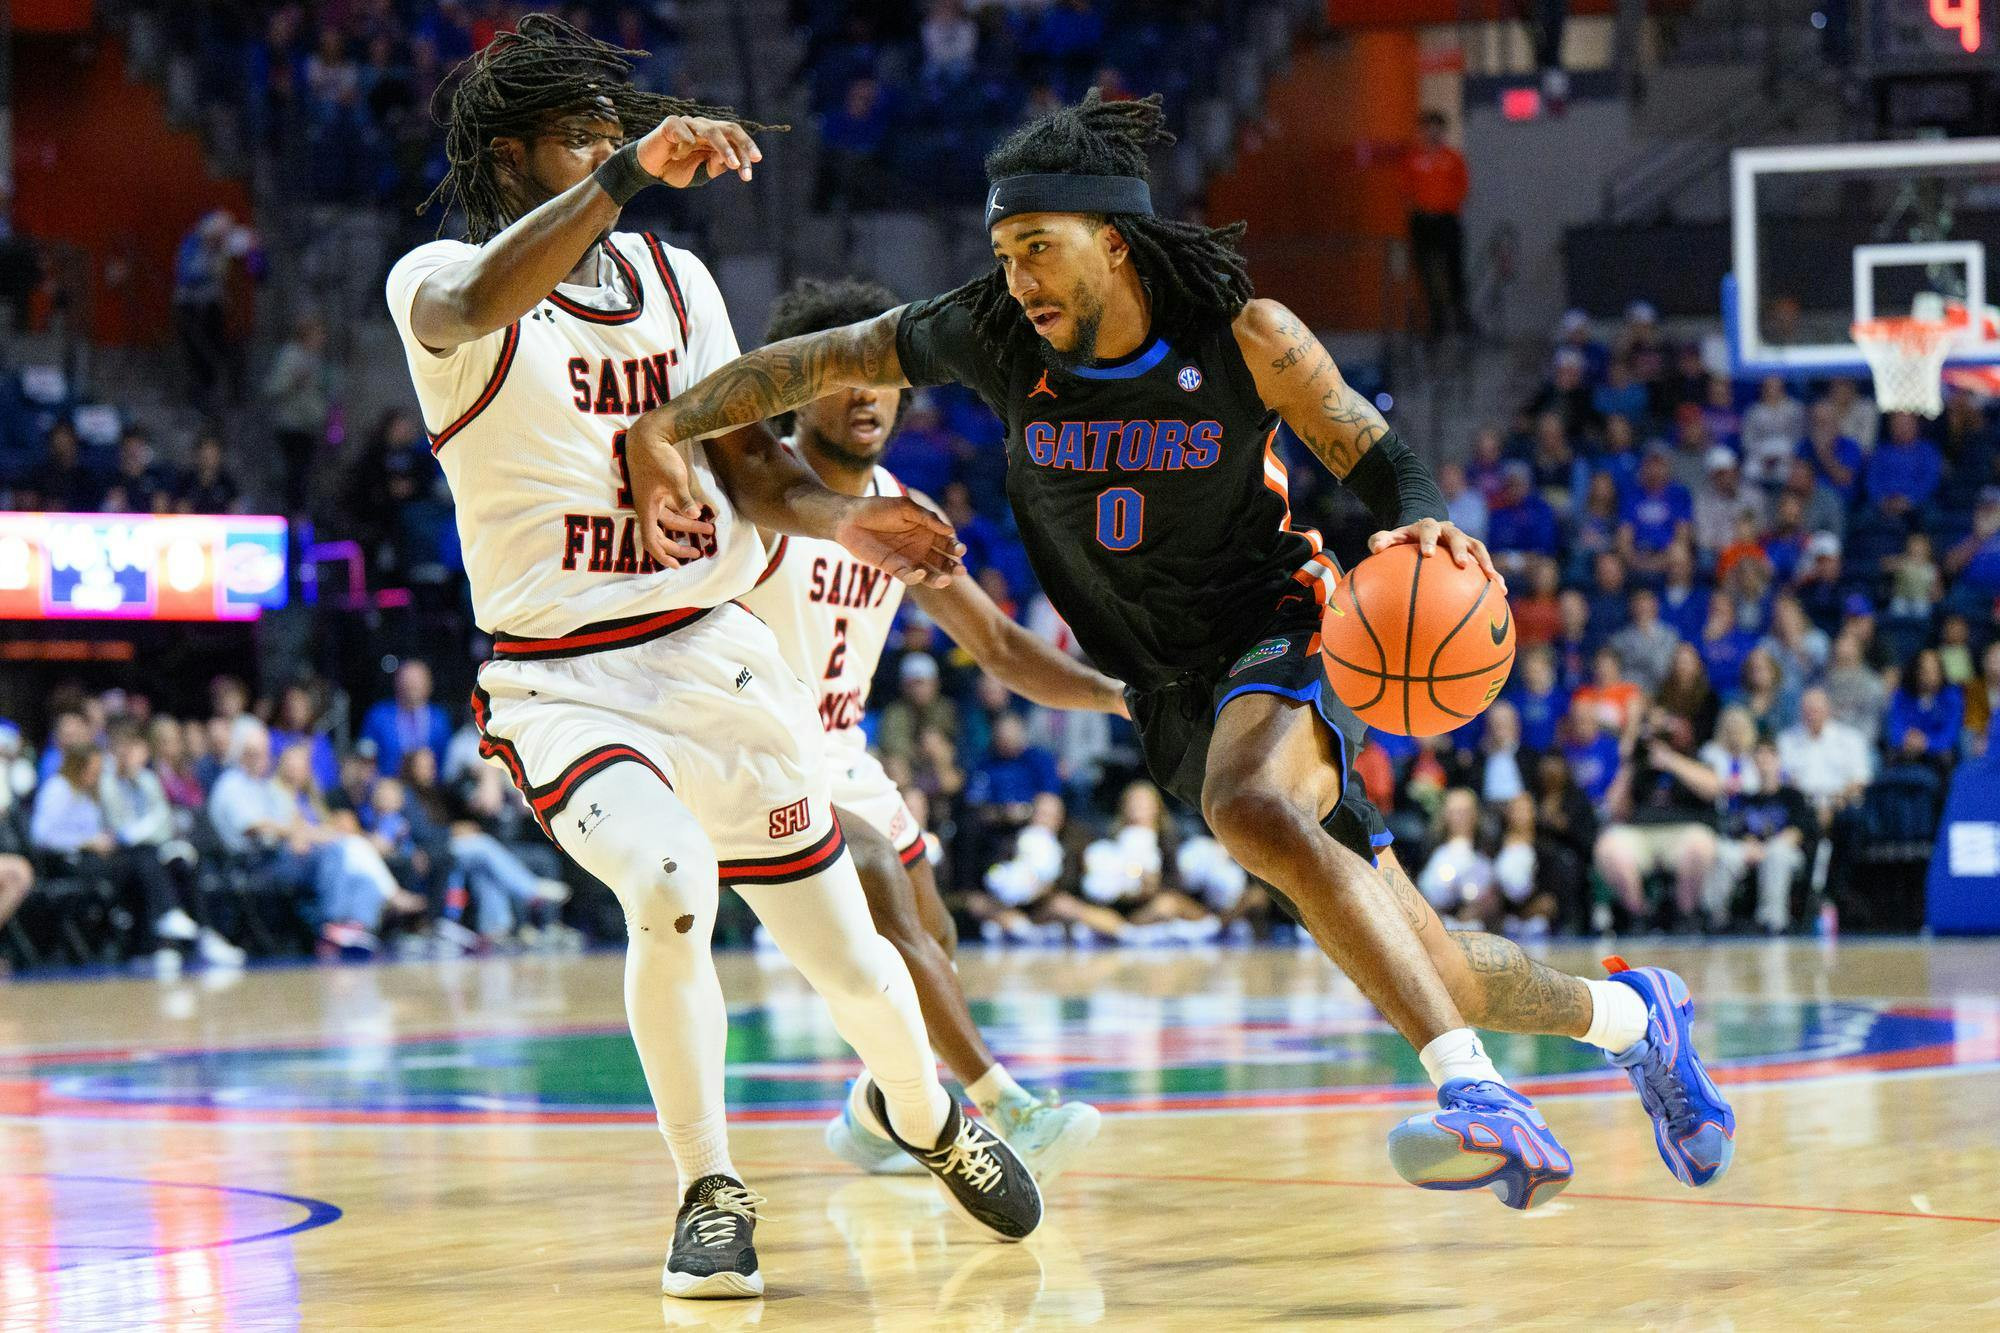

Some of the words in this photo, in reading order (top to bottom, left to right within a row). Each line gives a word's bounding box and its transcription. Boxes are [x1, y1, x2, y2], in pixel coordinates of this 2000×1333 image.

[567, 348, 679, 416] SAIN
[1178, 368, 1200, 390] SEC
[1025, 420, 1224, 472] GATORS
[1096, 487, 1145, 551] 0
[823, 617, 847, 680] 2
[735, 667, 750, 689] NEC
[769, 797, 810, 839] SFU
